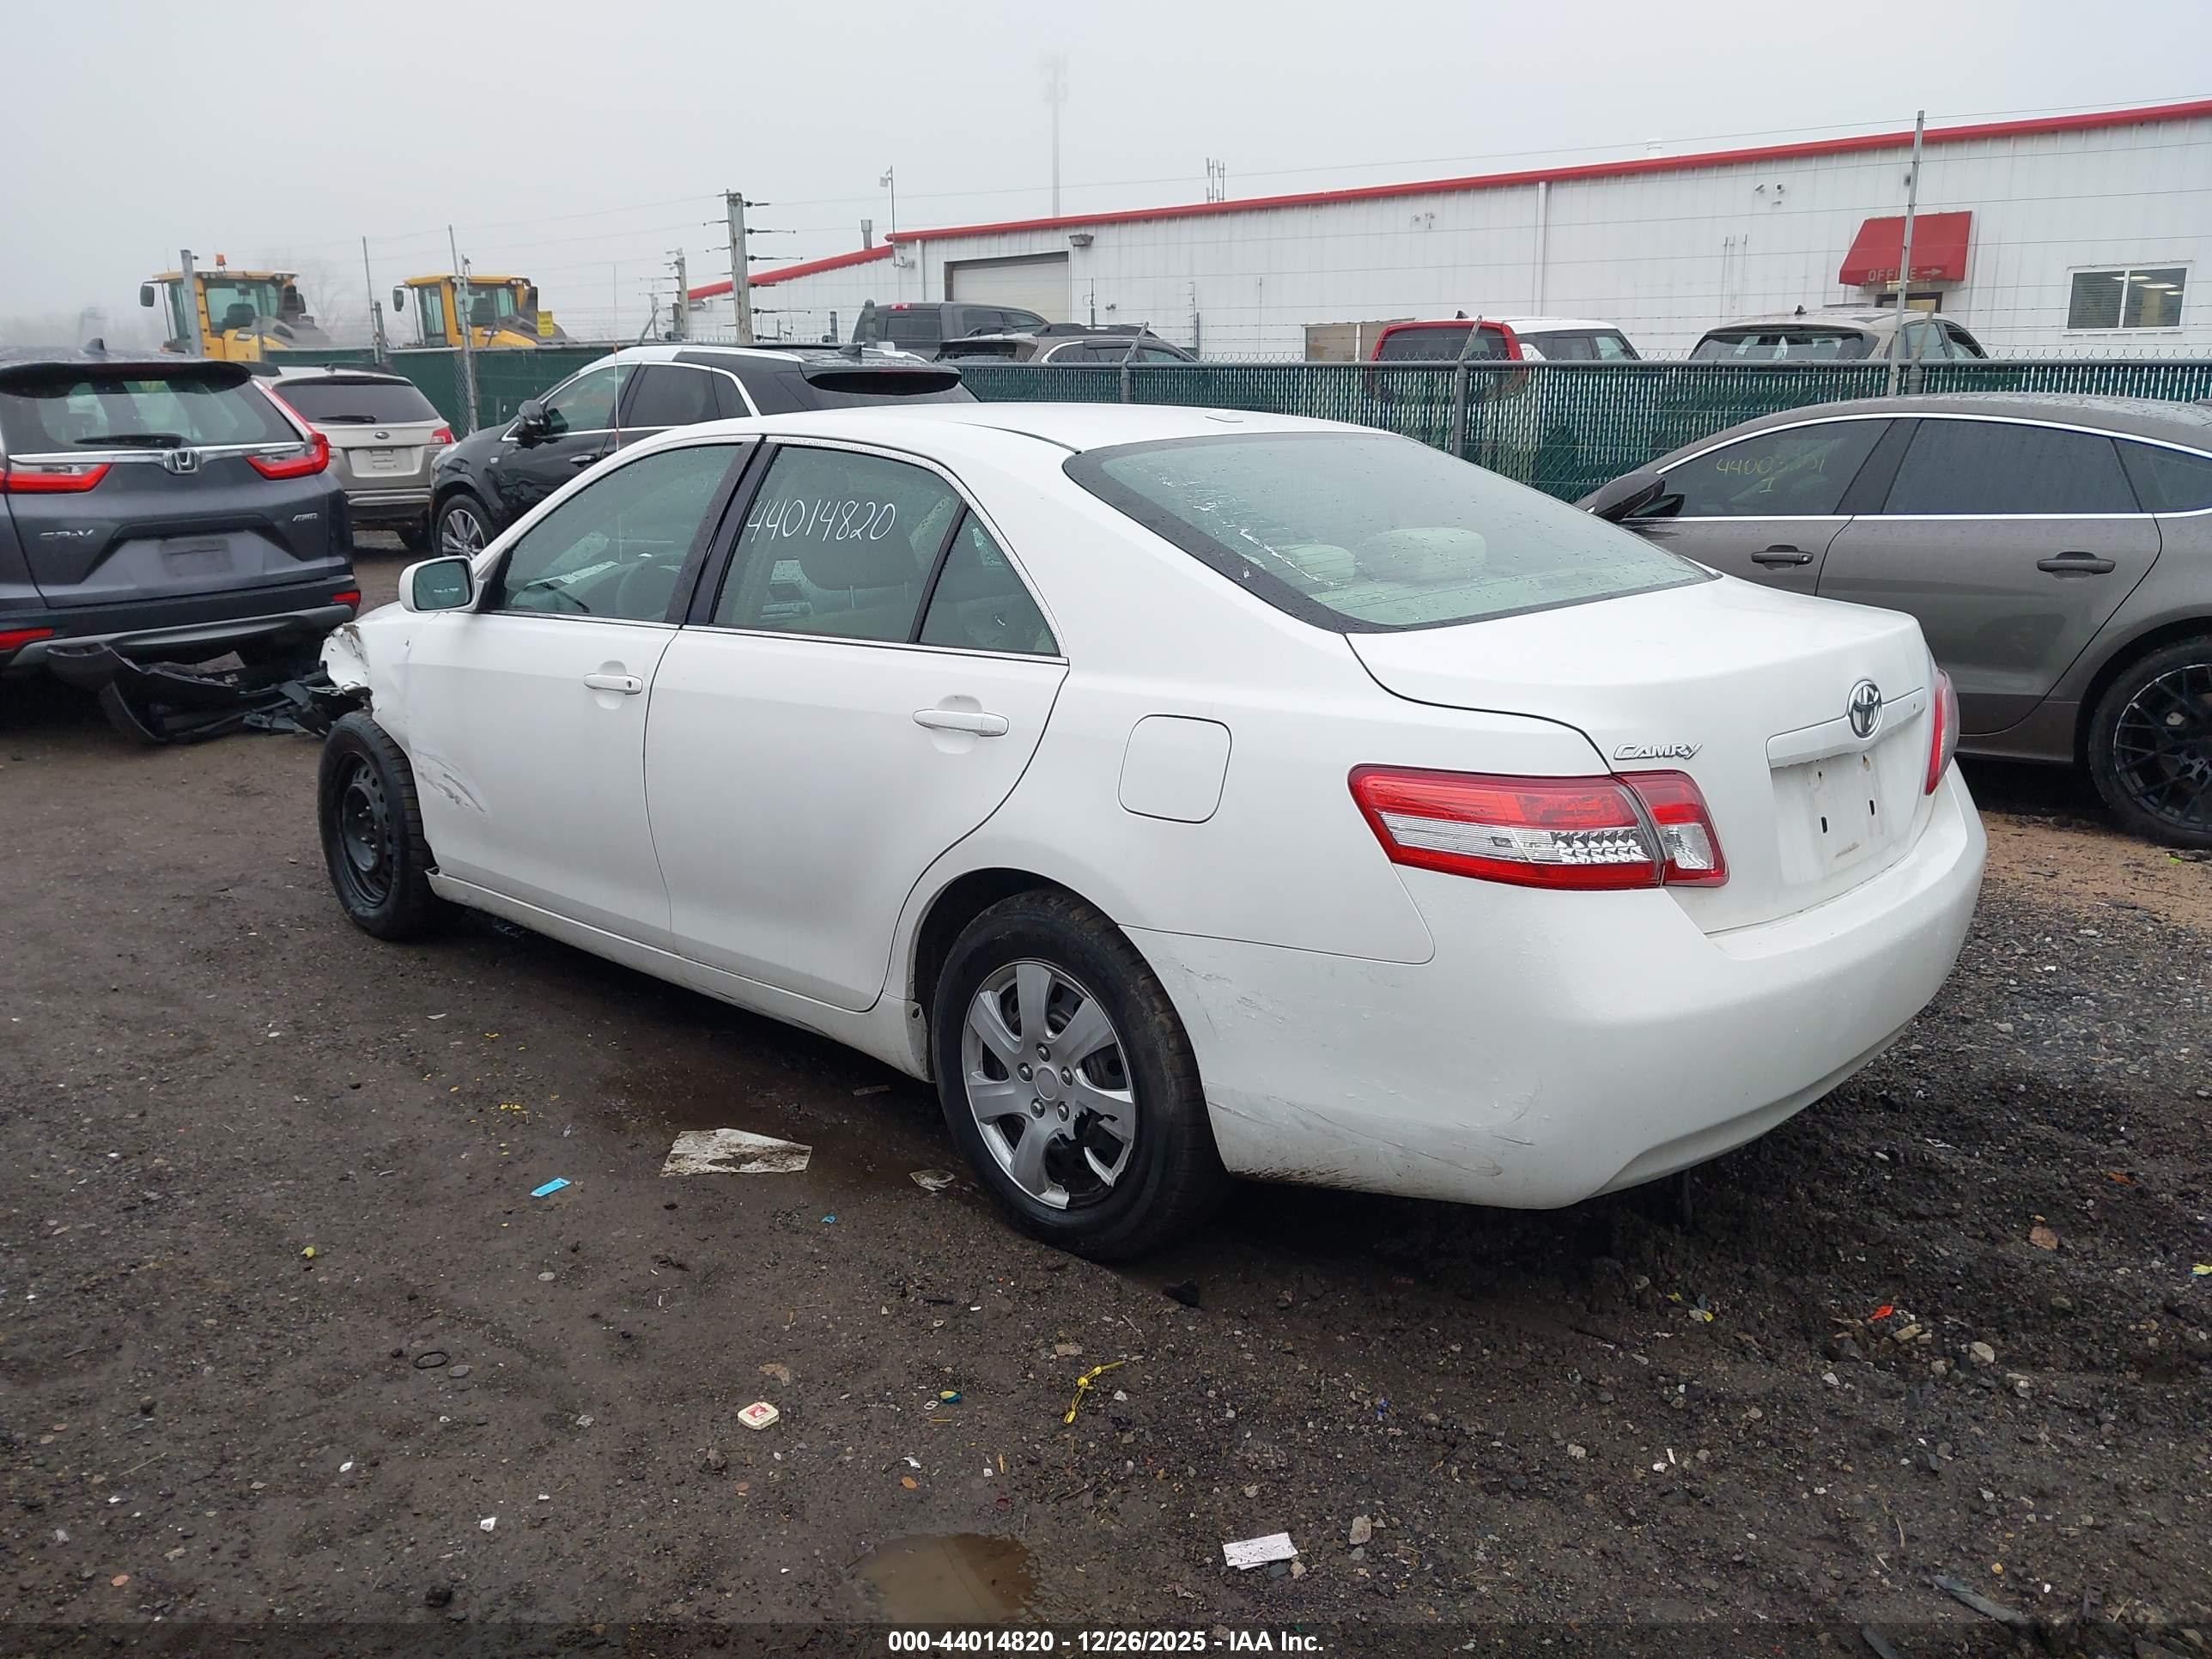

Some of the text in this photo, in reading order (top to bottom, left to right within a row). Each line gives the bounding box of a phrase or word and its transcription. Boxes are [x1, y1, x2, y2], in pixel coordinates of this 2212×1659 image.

[1868, 267, 1917, 282] OFFIE
[747, 498, 897, 543] 44014820
[1613, 742, 1703, 761] CAMRY
